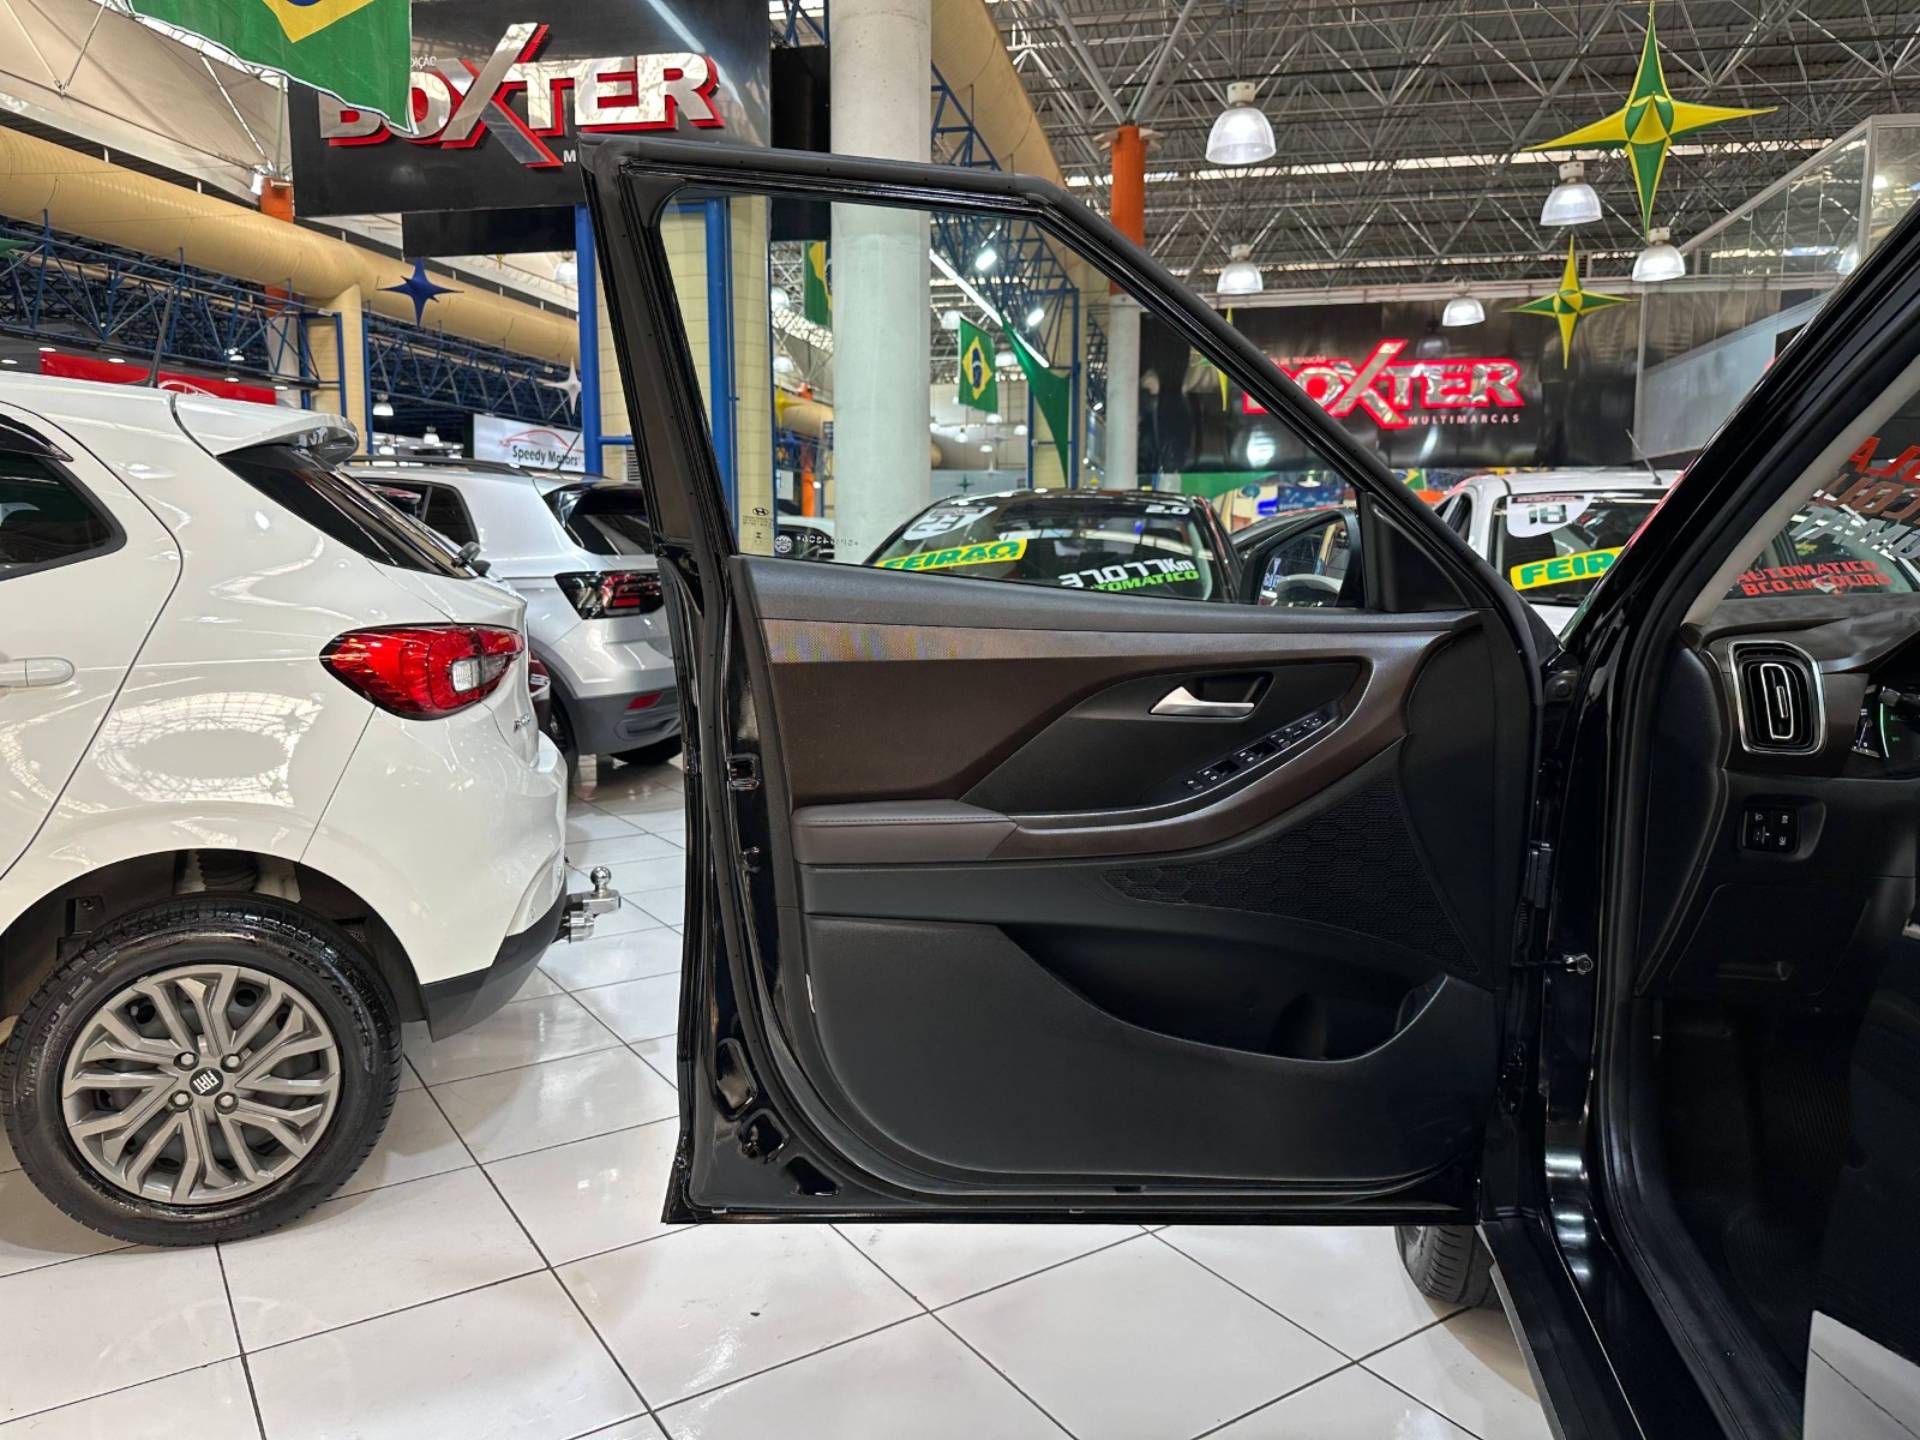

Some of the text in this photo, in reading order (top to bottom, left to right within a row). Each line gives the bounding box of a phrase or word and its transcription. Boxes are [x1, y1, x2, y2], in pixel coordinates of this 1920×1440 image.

[1242, 339, 1525, 429] OXTER
[1407, 413, 1519, 426] MULTIMARCAS
[512, 445, 578, 466] Speedy Motors
[1520, 551, 1618, 585] FEIR
[1092, 569, 1200, 591] TOMATICO
[192, 1070, 220, 1094] FIAT
